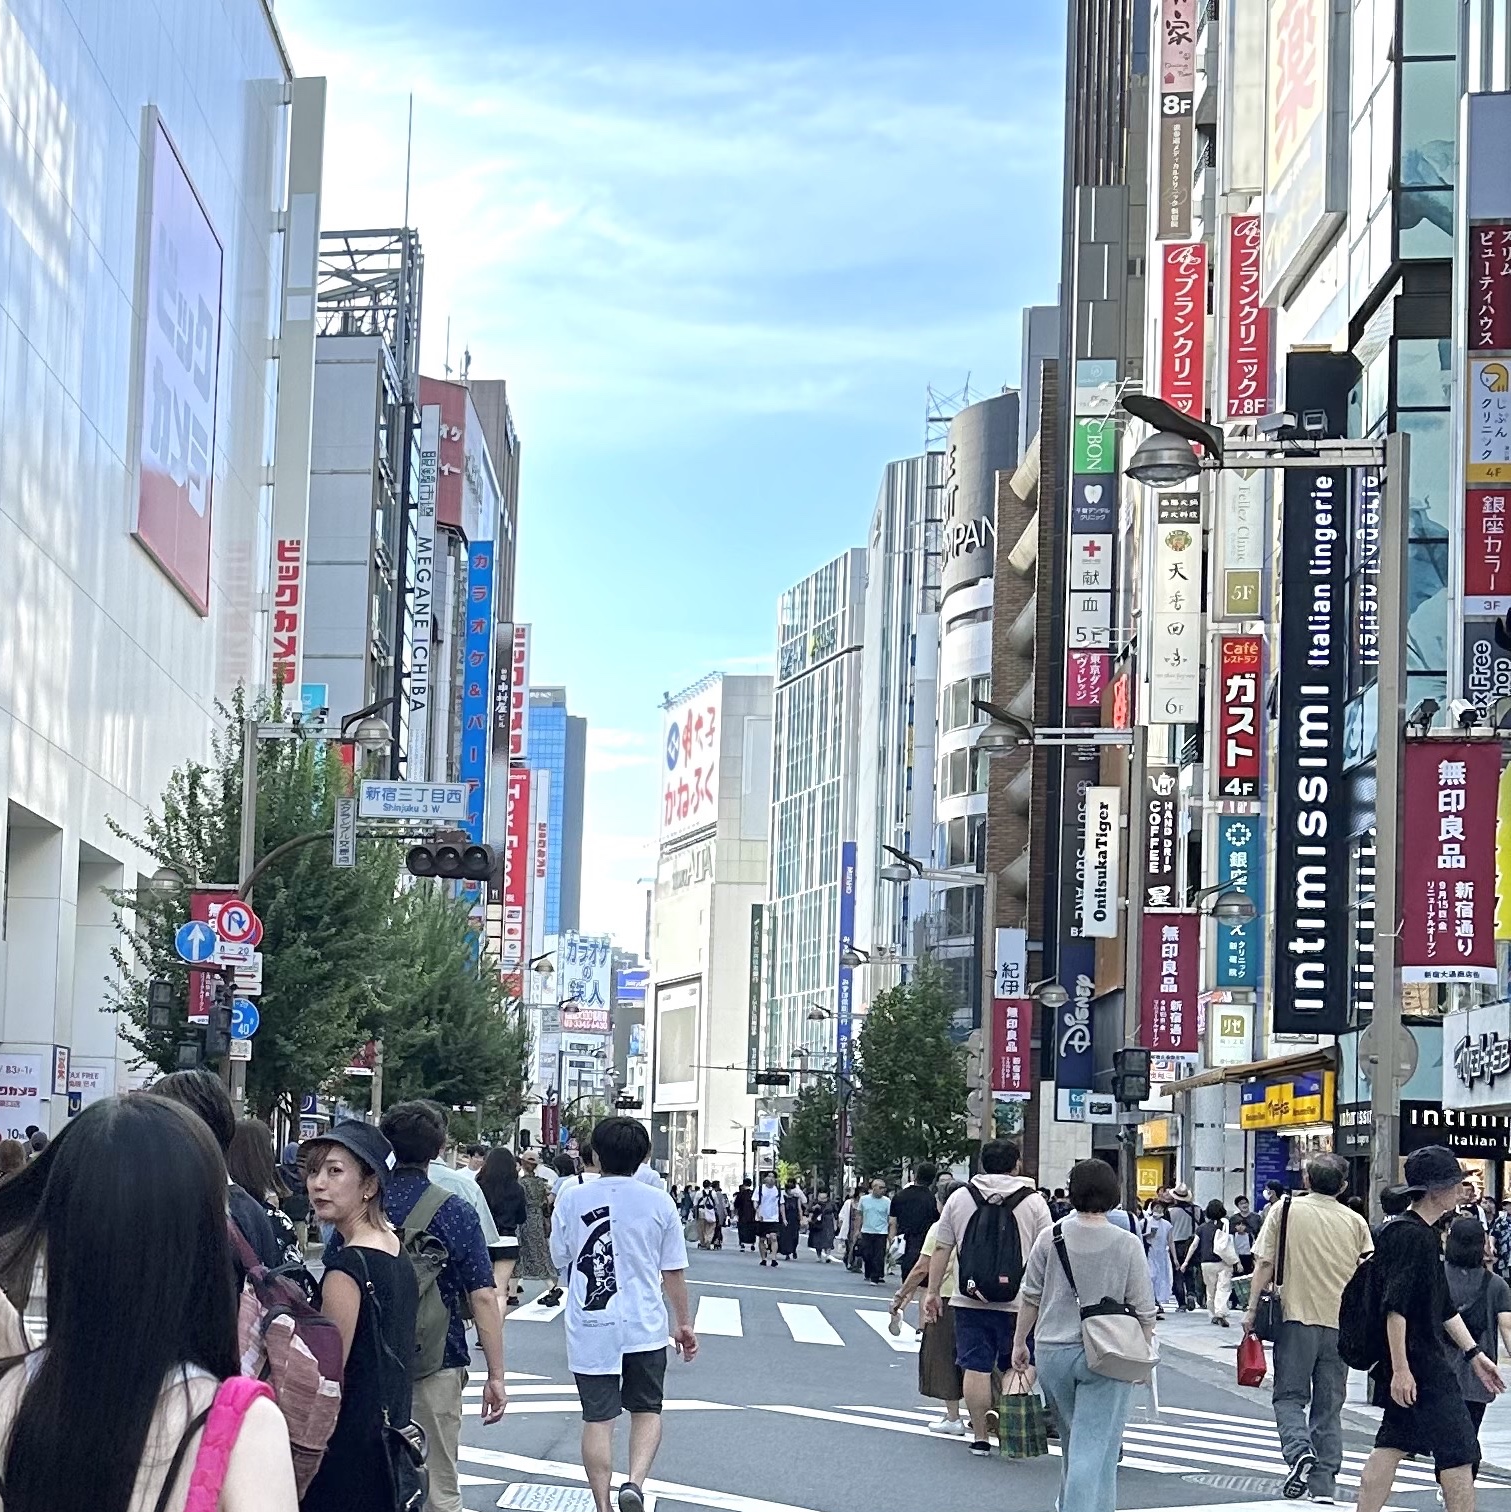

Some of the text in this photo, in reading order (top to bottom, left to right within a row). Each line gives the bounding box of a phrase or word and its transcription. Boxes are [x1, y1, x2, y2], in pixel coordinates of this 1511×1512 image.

[1163, 95, 1191, 115] 8F
[1477, 231, 1495, 346] ビューティハウス
[1171, 274, 1198, 415] ブランクリニッ
[1236, 247, 1261, 398] ブランクリニック
[1229, 399, 1266, 415] 7.8F
[1087, 418, 1102, 470] CBON
[1482, 495, 1505, 591] 銀座カラー
[413, 537, 433, 628] MEGANE
[1082, 570, 1100, 612] 献血
[1231, 585, 1255, 601] 5F
[1308, 475, 1333, 667] Italian lingerie
[272, 540, 300, 685] ビックカメラ
[1483, 600, 1501, 611] 3F
[1223, 642, 1258, 655] Café
[1223, 656, 1258, 664] レストラン
[1471, 640, 1489, 690] Free
[410, 638, 428, 712] ICHIBA
[1089, 654, 1101, 704] 東京ダンス
[1492, 657, 1511, 698] hop
[1165, 697, 1184, 715] 6F
[1225, 673, 1257, 767] ガスト
[682, 706, 716, 768] 明太子
[366, 786, 462, 804] 新宿三丁目西
[383, 803, 419, 813] Shinjuku
[422, 804, 428, 812] 3
[664, 762, 715, 827] かねふく
[1224, 777, 1253, 796] 4F
[1149, 801, 1161, 873] COFFEE
[1163, 801, 1173, 873] HAND DRIP
[1437, 760, 1466, 869] 無印良品
[1288, 683, 1329, 1010] intimissimi
[1426, 881, 1435, 958] リニューアルオープン
[1454, 881, 1474, 957] 新宿通り
[566, 938, 611, 966] カラオケ
[1160, 925, 1179, 993] 無印良品
[568, 980, 604, 1007] 鉄人
[1001, 962, 1019, 996] 紀伊
[237, 1024, 250, 1035] 40
[1006, 1007, 1019, 1053] 無印良品
[1060, 974, 1096, 1058] Disney
[1169, 1000, 1183, 1047] 新宿通り
[1223, 1019, 1241, 1033] リゼ
[1448, 1134, 1496, 1147] Italian
